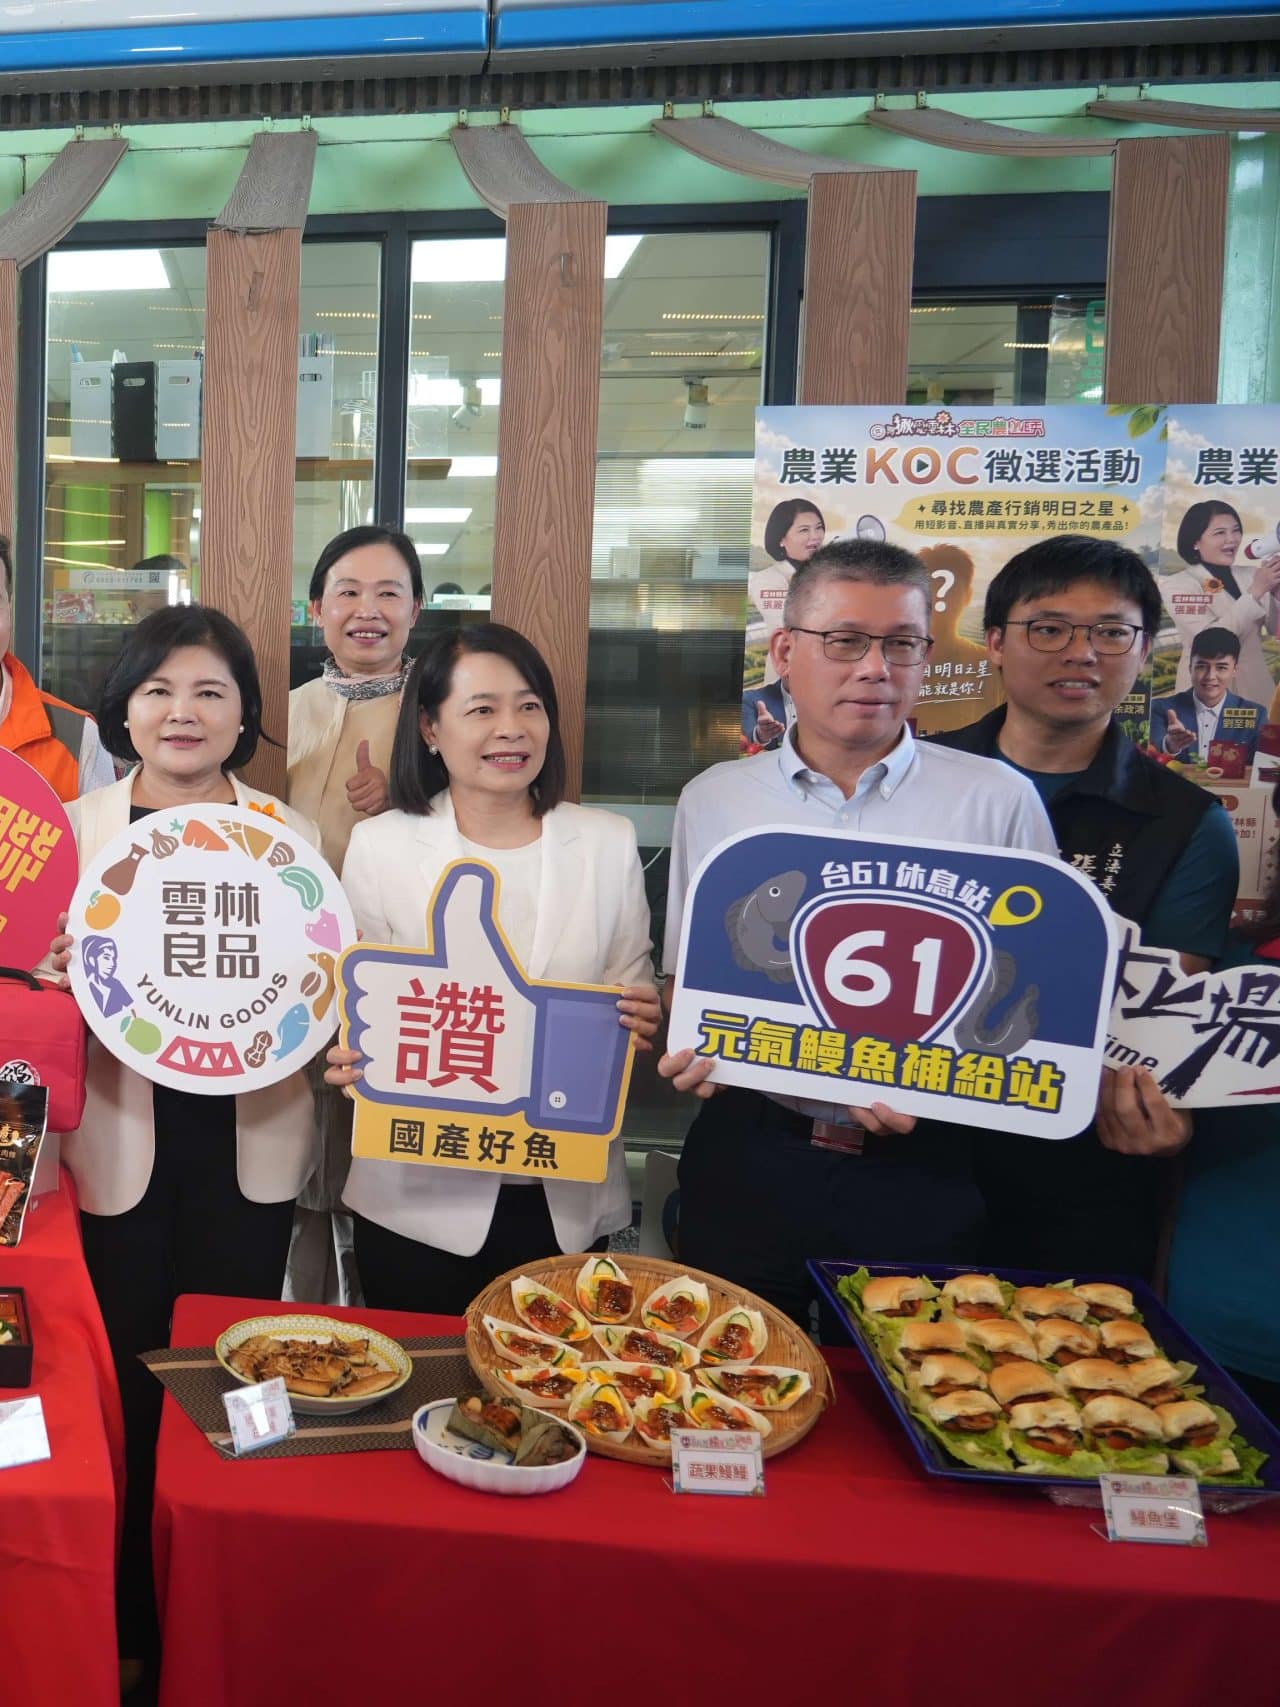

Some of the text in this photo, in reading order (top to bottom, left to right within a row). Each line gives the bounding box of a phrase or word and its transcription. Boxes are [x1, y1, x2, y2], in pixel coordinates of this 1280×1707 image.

[1195, 447, 1279, 486] 農業
[931, 499, 1116, 517] 尋找農產行銷明日之星
[162, 880, 261, 927] 雲林
[820, 860, 994, 912] 台61休息站
[163, 931, 260, 979] 良品
[824, 930, 944, 1016] 61
[136, 972, 288, 1030] YUNLIN GOODS
[395, 977, 506, 1094] 讚
[697, 1008, 1066, 1114] 元氣鰻魚補給站
[388, 1117, 560, 1171] 國產好魚
